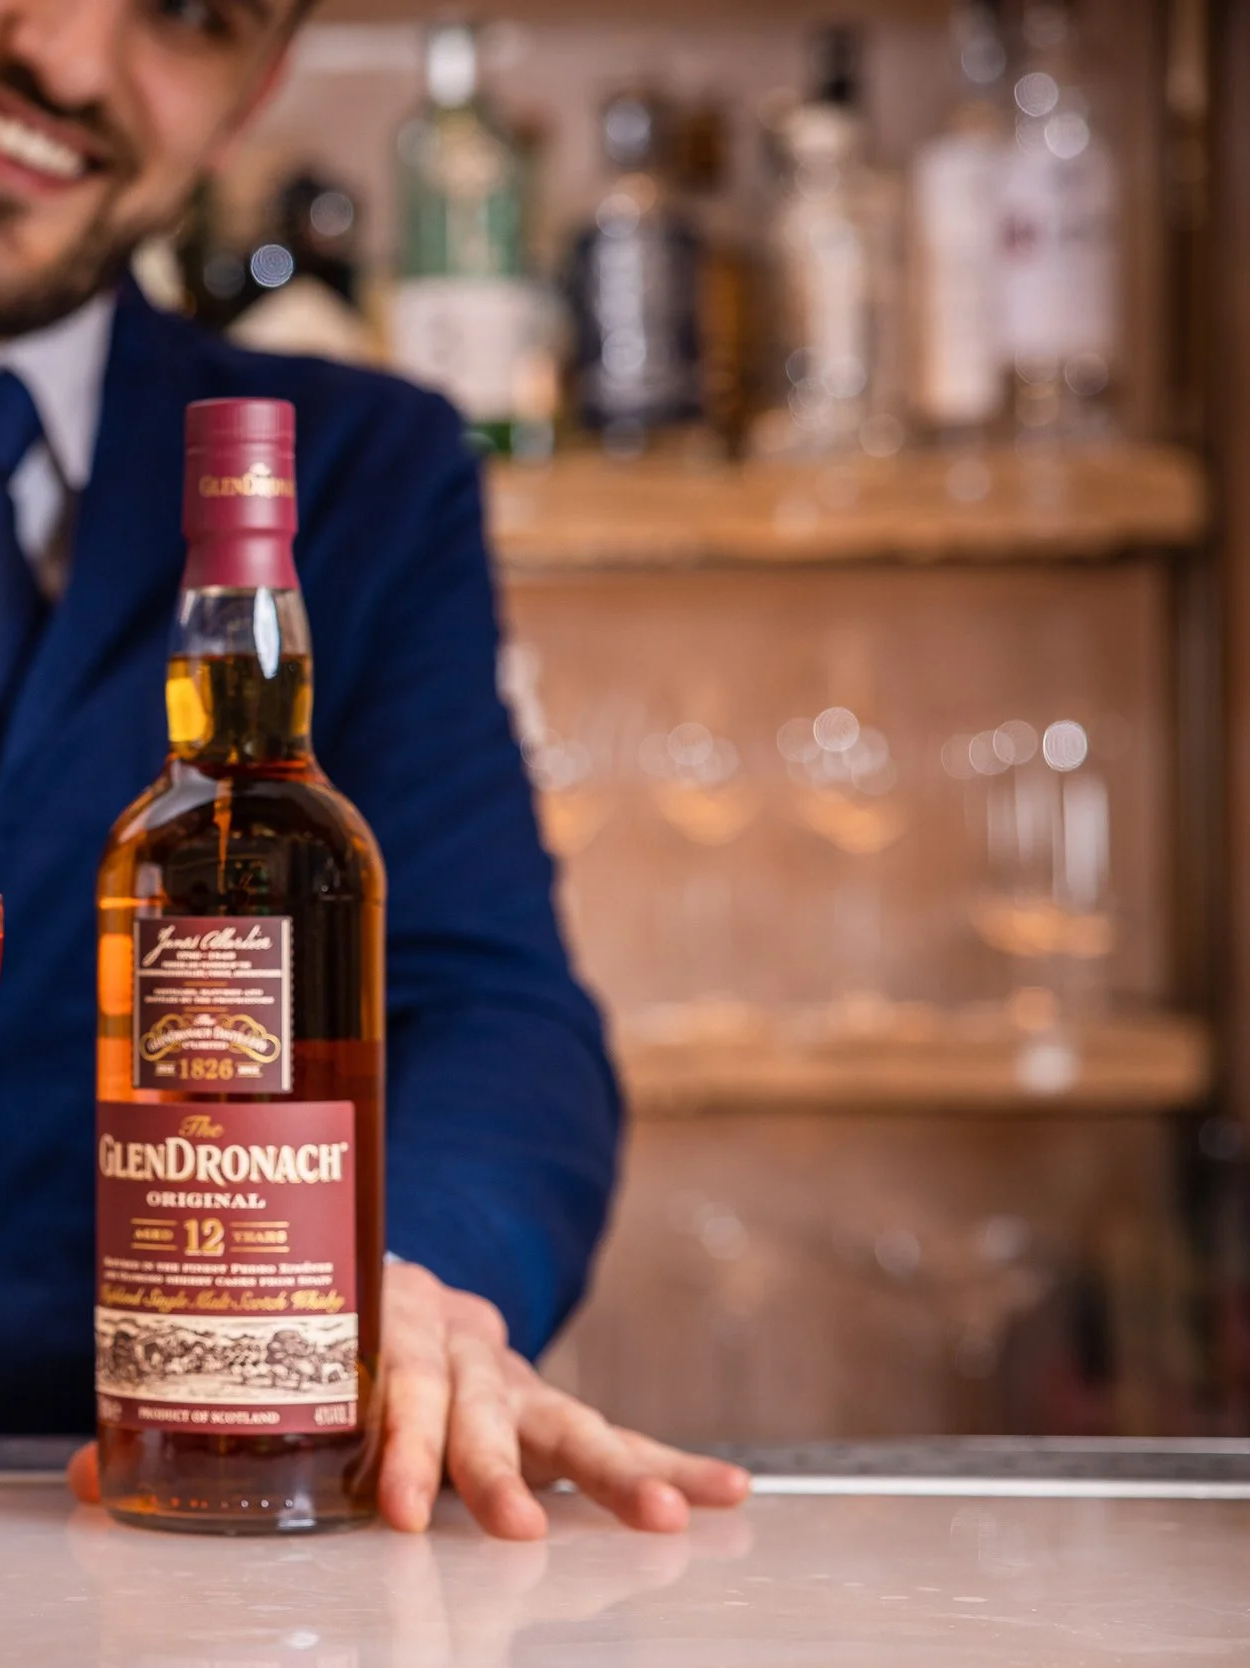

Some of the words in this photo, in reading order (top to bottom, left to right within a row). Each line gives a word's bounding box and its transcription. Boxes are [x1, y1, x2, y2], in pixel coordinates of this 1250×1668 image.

[179, 1058, 234, 1080] 1826
[179, 1114, 224, 1138] The
[146, 1191, 266, 1209] ORIGINAL
[133, 1227, 174, 1242] AGED
[183, 1217, 225, 1256] 12
[231, 1230, 288, 1244] YEARS
[137, 1405, 189, 1423] PRODUCT
[190, 1410, 209, 1424] OF
[210, 1410, 281, 1425] SCOTLAND
